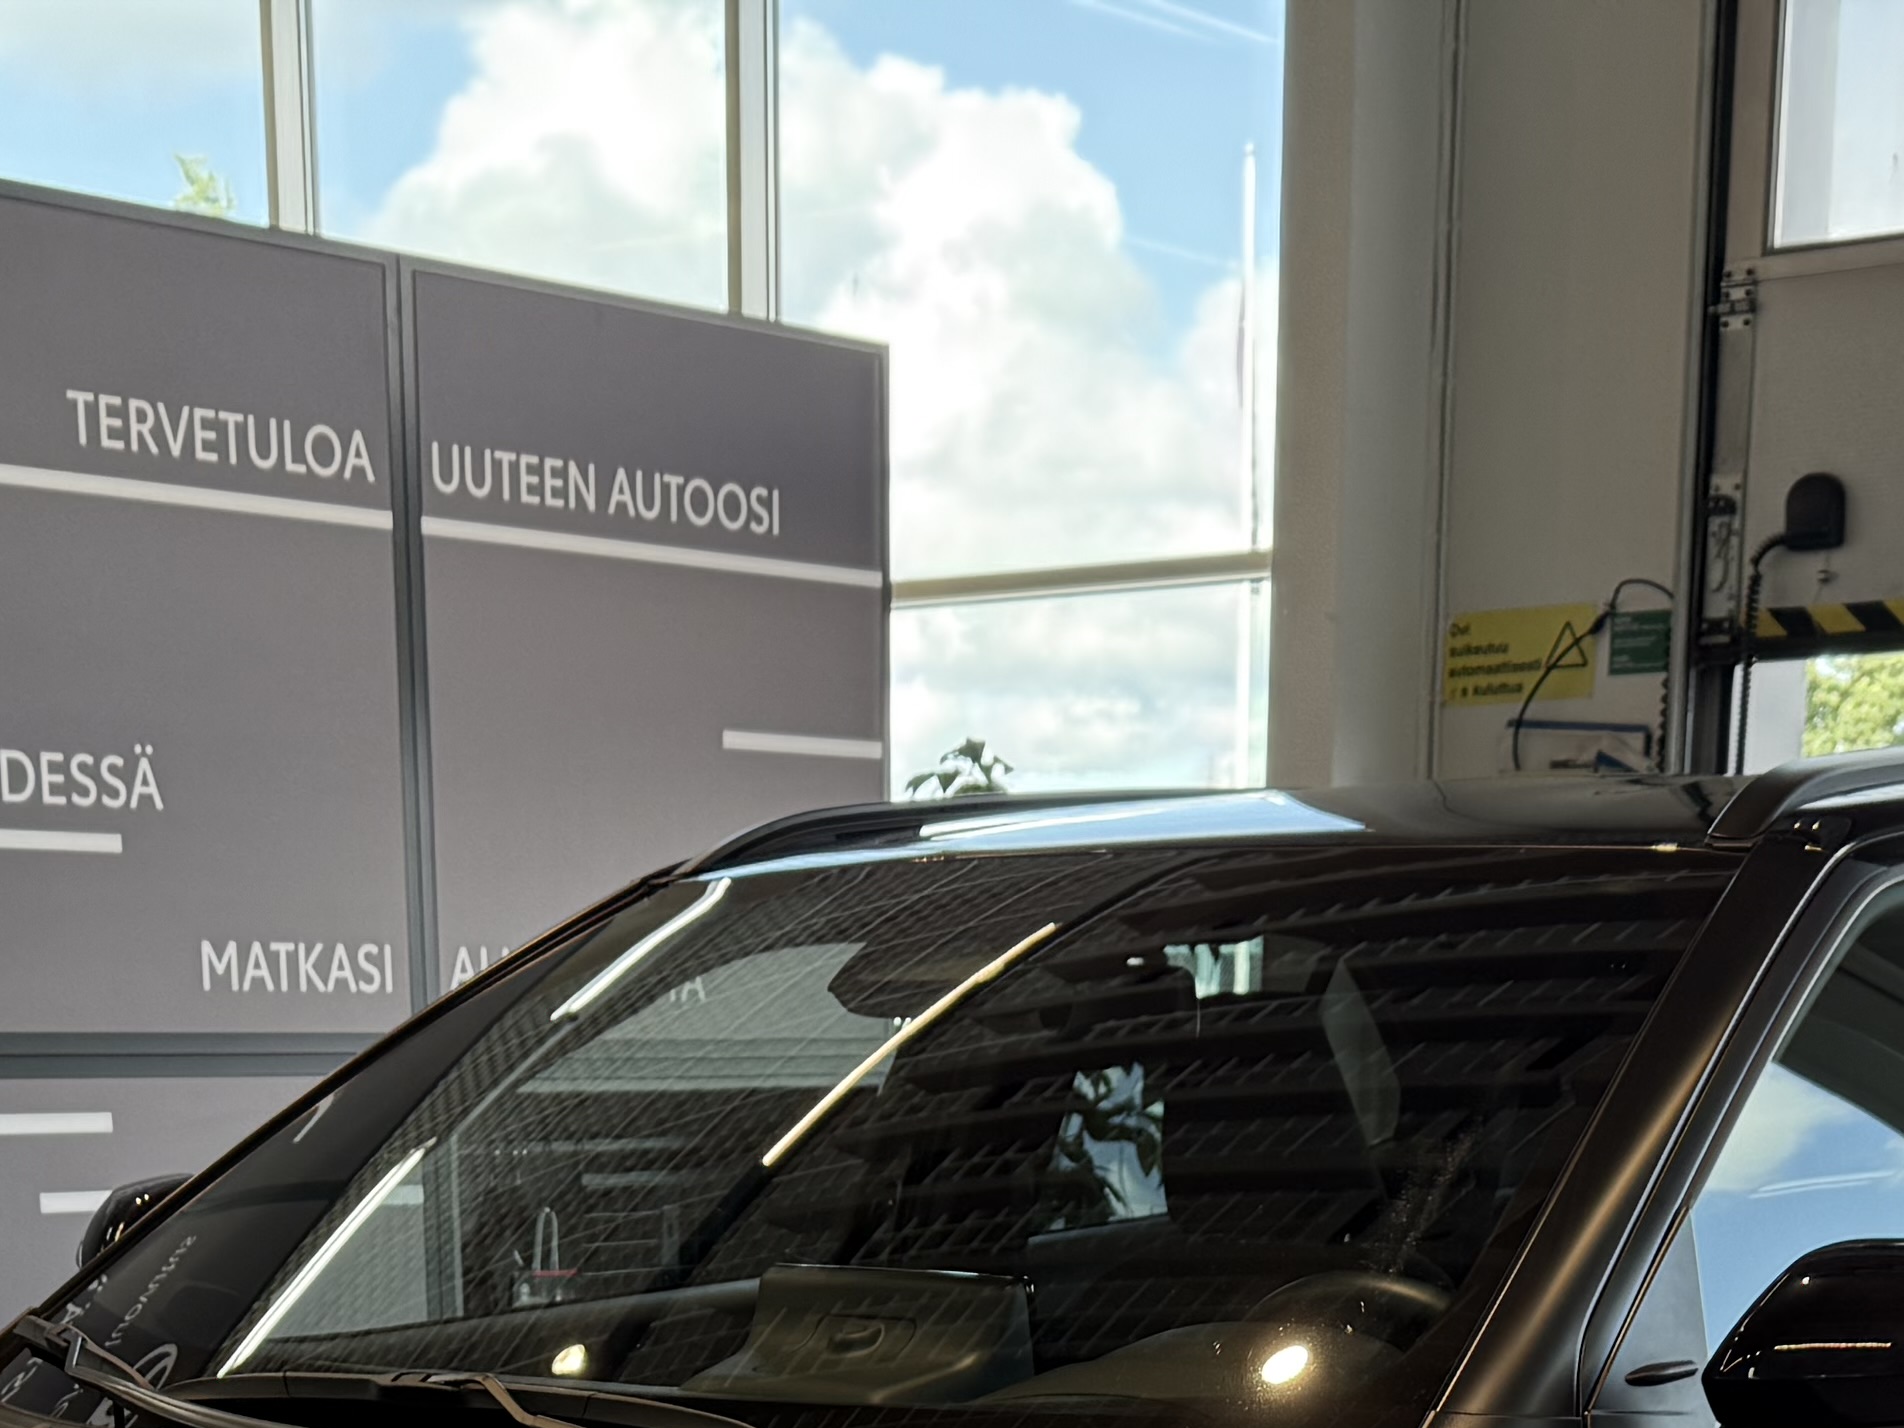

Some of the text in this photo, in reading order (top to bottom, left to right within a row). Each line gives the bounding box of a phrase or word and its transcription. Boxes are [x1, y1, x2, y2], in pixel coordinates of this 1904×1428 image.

[65, 388, 781, 537] TERVETULOA UUTEEN AUTOOSI
[200, 939, 393, 994] MATKASI
